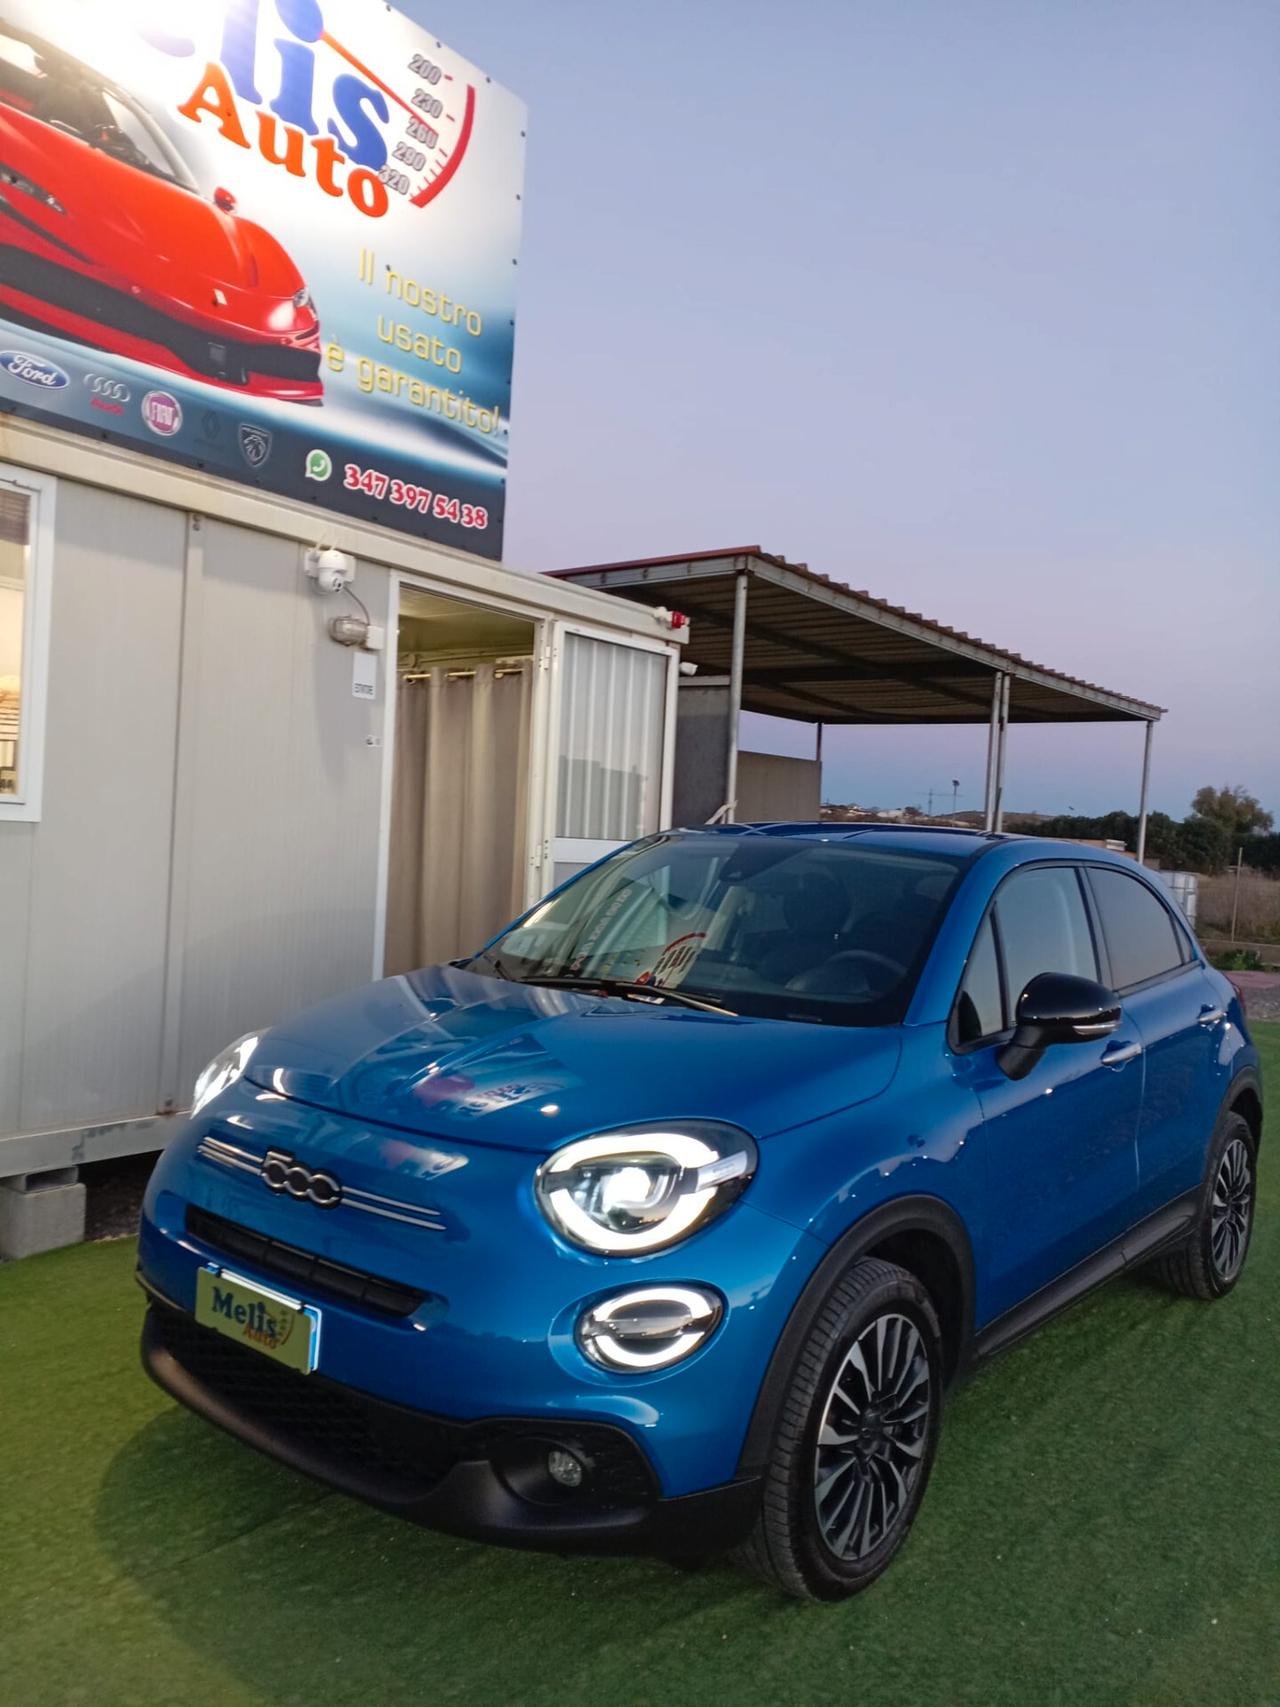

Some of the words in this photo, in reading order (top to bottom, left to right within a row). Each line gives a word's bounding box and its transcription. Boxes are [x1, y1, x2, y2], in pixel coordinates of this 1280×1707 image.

[407, 53, 442, 85] 200
[411, 88, 443, 119] 230
[177, 62, 389, 218] Auto
[392, 141, 427, 172] 290
[378, 164, 411, 195] 320
[358, 248, 374, 285] Il
[385, 270, 482, 336] nostro
[377, 314, 462, 373] usato
[8, 354, 56, 386] Ford
[326, 334, 345, 372] è
[356, 356, 500, 437] garantito!
[344, 463, 389, 499] 347
[390, 480, 431, 513] 397
[261, 1149, 343, 1206] 500
[211, 1285, 278, 1339] Melis
[242, 1323, 281, 1350] Auto
